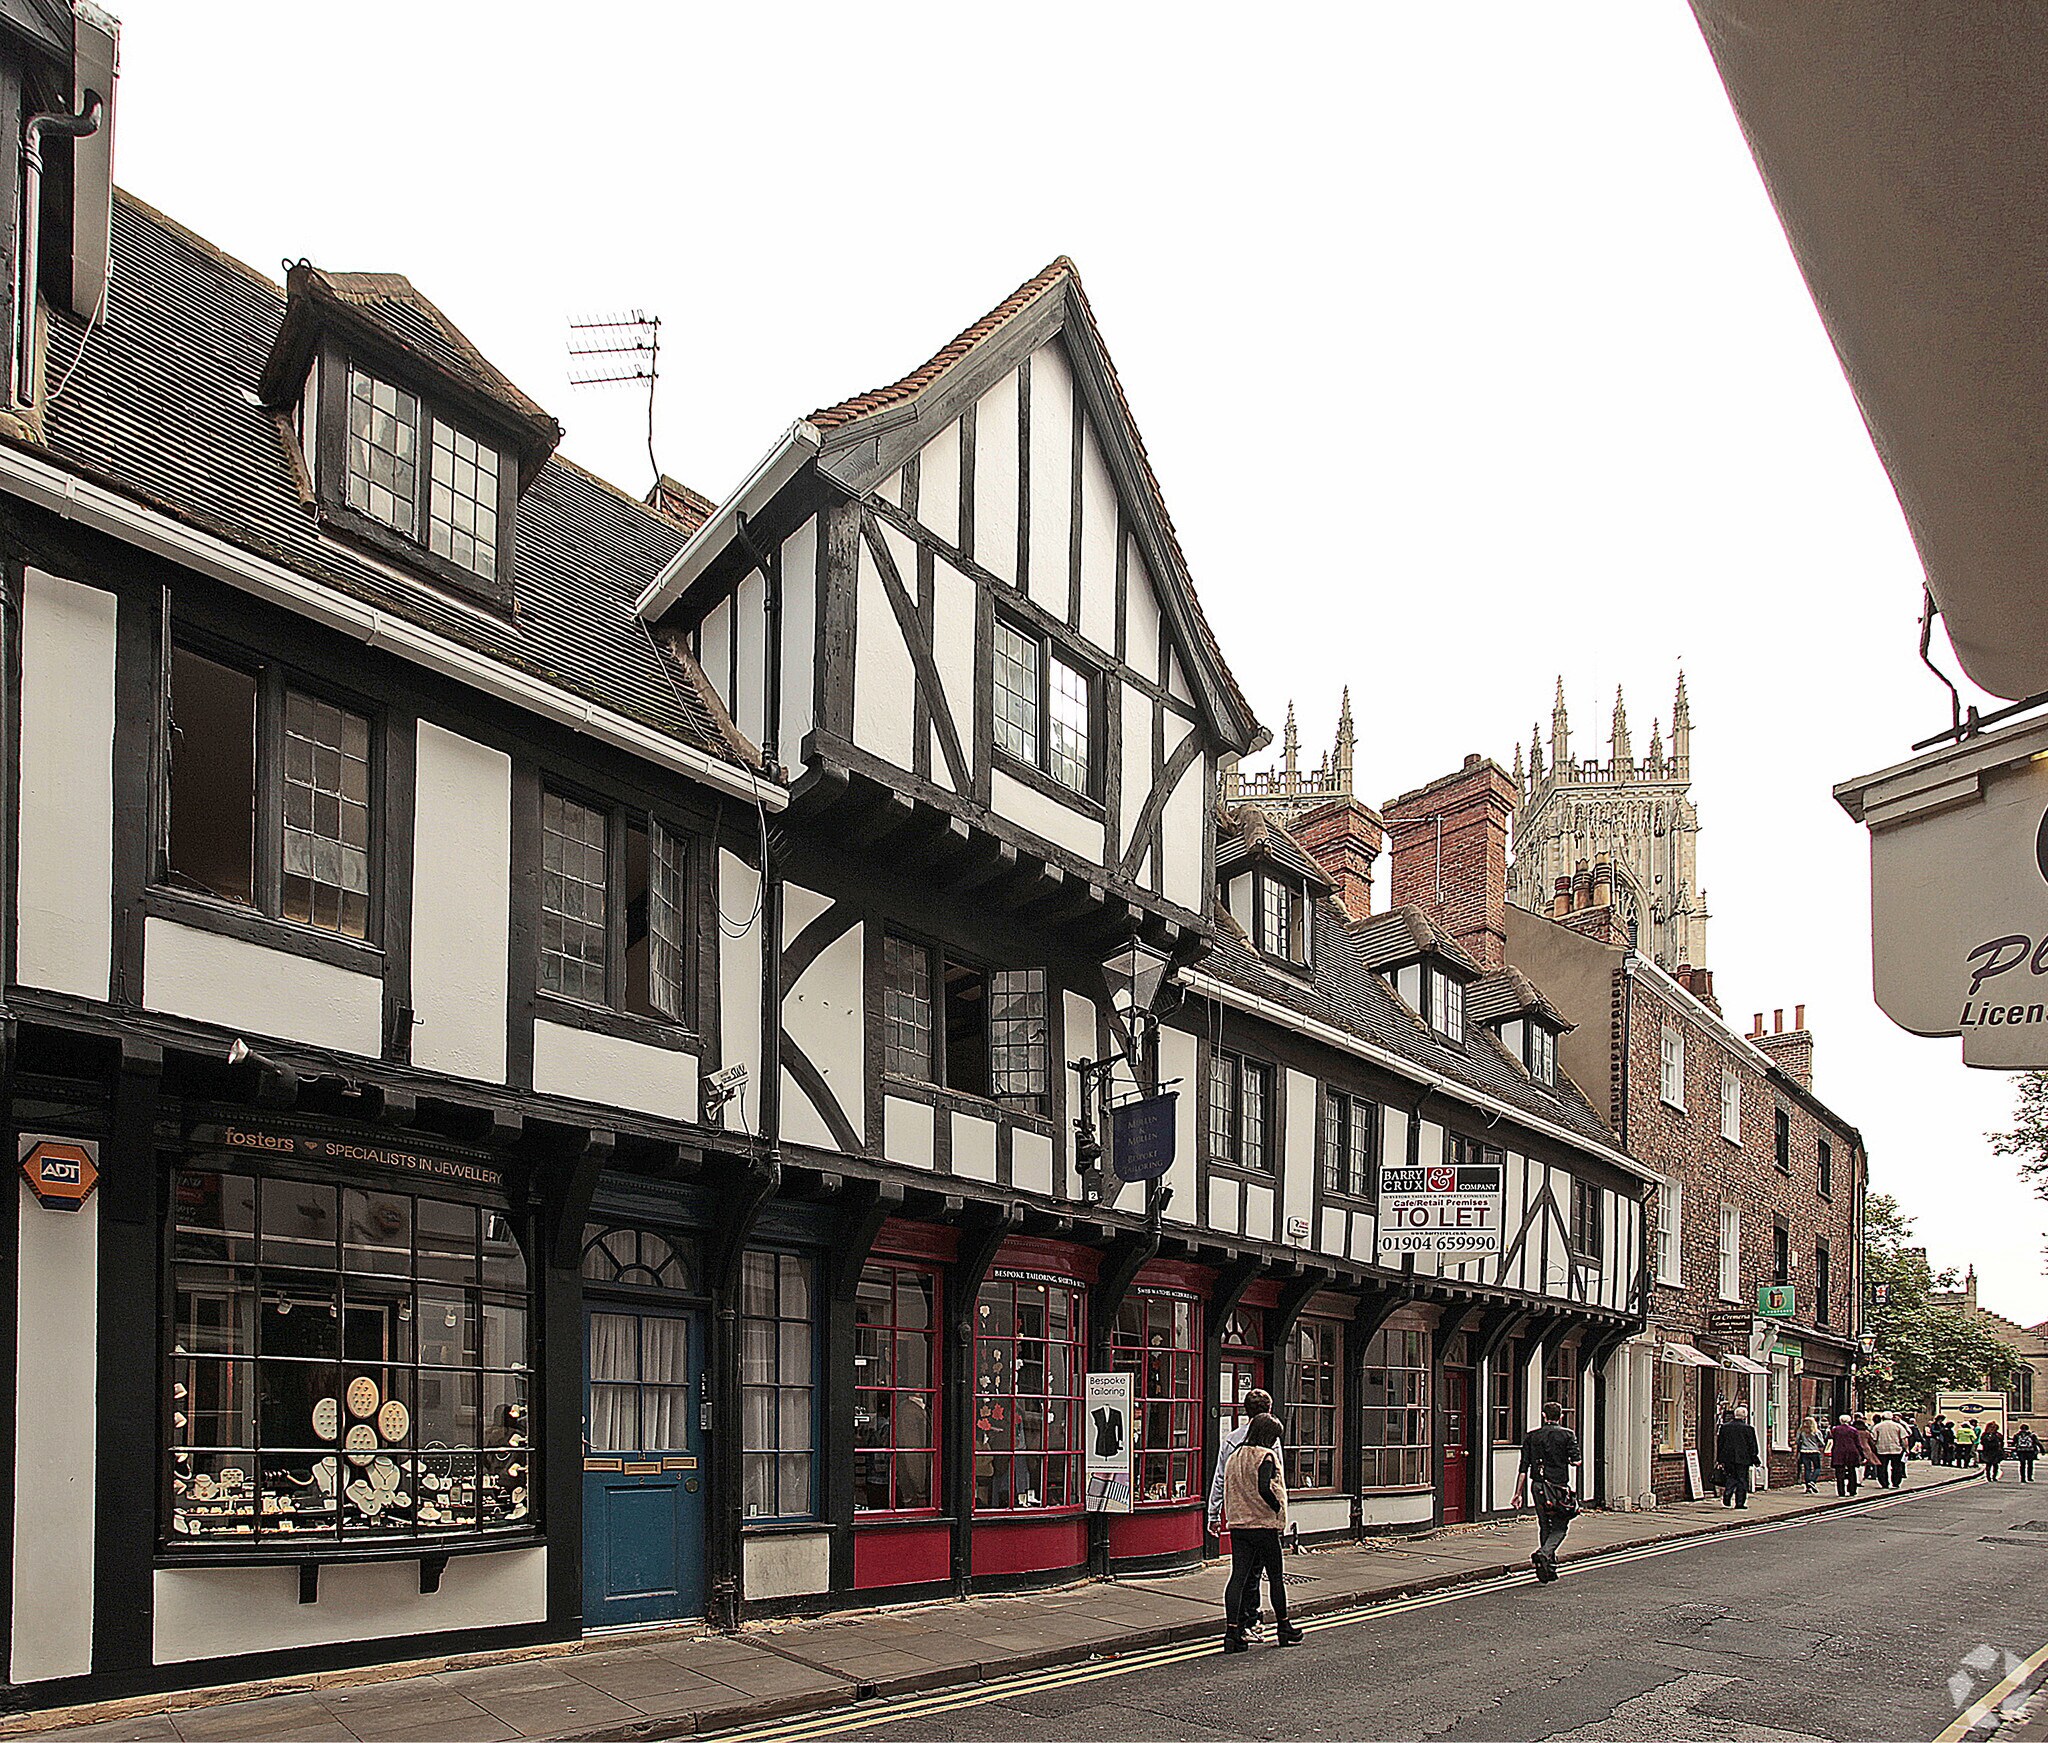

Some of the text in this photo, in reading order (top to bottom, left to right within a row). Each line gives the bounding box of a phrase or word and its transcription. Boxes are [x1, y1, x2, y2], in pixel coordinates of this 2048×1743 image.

[1960, 1001, 2048, 1026] Licen
[224, 1126, 503, 1185] fosters SPECIALISTS IN JEWELLERY
[41, 1162, 79, 1179] ADT
[1383, 1170, 1424, 1181] BARRY
[1383, 1168, 1497, 1191] CRUX & COMPANY
[1393, 1199, 1443, 1207] Cafe/Retail
[1392, 1207, 1490, 1228] TO LET
[1382, 1237, 1495, 1250] 01904 659990
[994, 1270, 1025, 1278] BESPOKE
[1089, 1376, 1126, 1386] Bespoke
[1090, 1387, 1126, 1397] Tailoring
